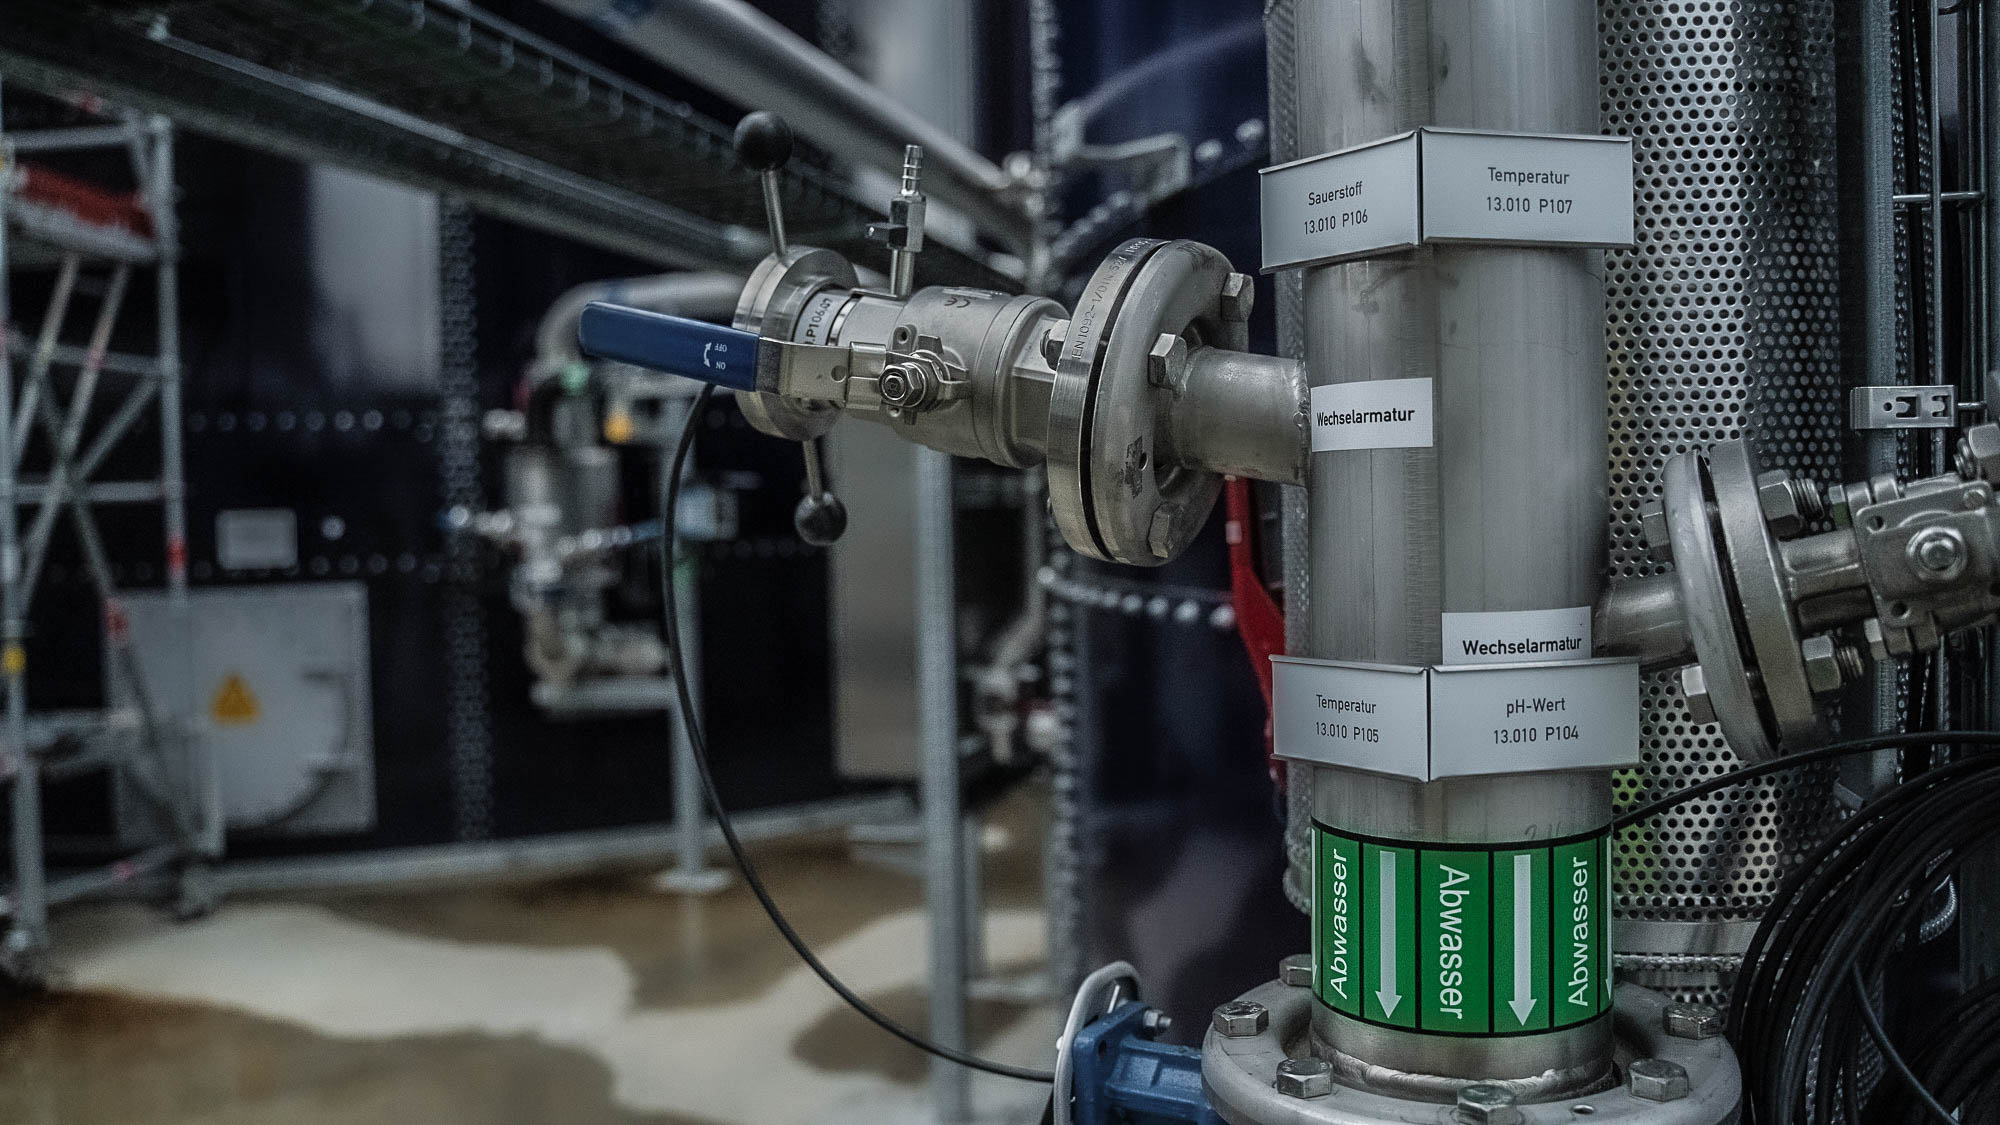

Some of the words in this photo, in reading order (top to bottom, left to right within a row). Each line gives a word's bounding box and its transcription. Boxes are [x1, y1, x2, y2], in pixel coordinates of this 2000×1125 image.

[1487, 166, 1570, 187] Temperatur
[1308, 180, 1363, 206] Sauerstoff
[1486, 196, 1531, 213] 13.010
[1539, 198, 1573, 215] P107
[1303, 215, 1336, 235] 13.010
[1342, 208, 1368, 228] P106
[714, 343, 728, 352] OFF
[715, 361, 726, 370] ON
[1316, 407, 1416, 427] Wechselarmatur
[1462, 636, 1582, 656] Wechselarmatur
[1315, 693, 1377, 714] Temperatur
[1506, 697, 1566, 718] pH-Wert
[1315, 721, 1348, 739] 13.010
[1353, 726, 1380, 744] P105
[1493, 727, 1537, 745] 13.010
[1545, 724, 1579, 741] P104
[1330, 848, 1348, 1000] Abwasser
[1567, 856, 1589, 1007] Abwasser
[1439, 863, 1470, 1020] Abwasser
